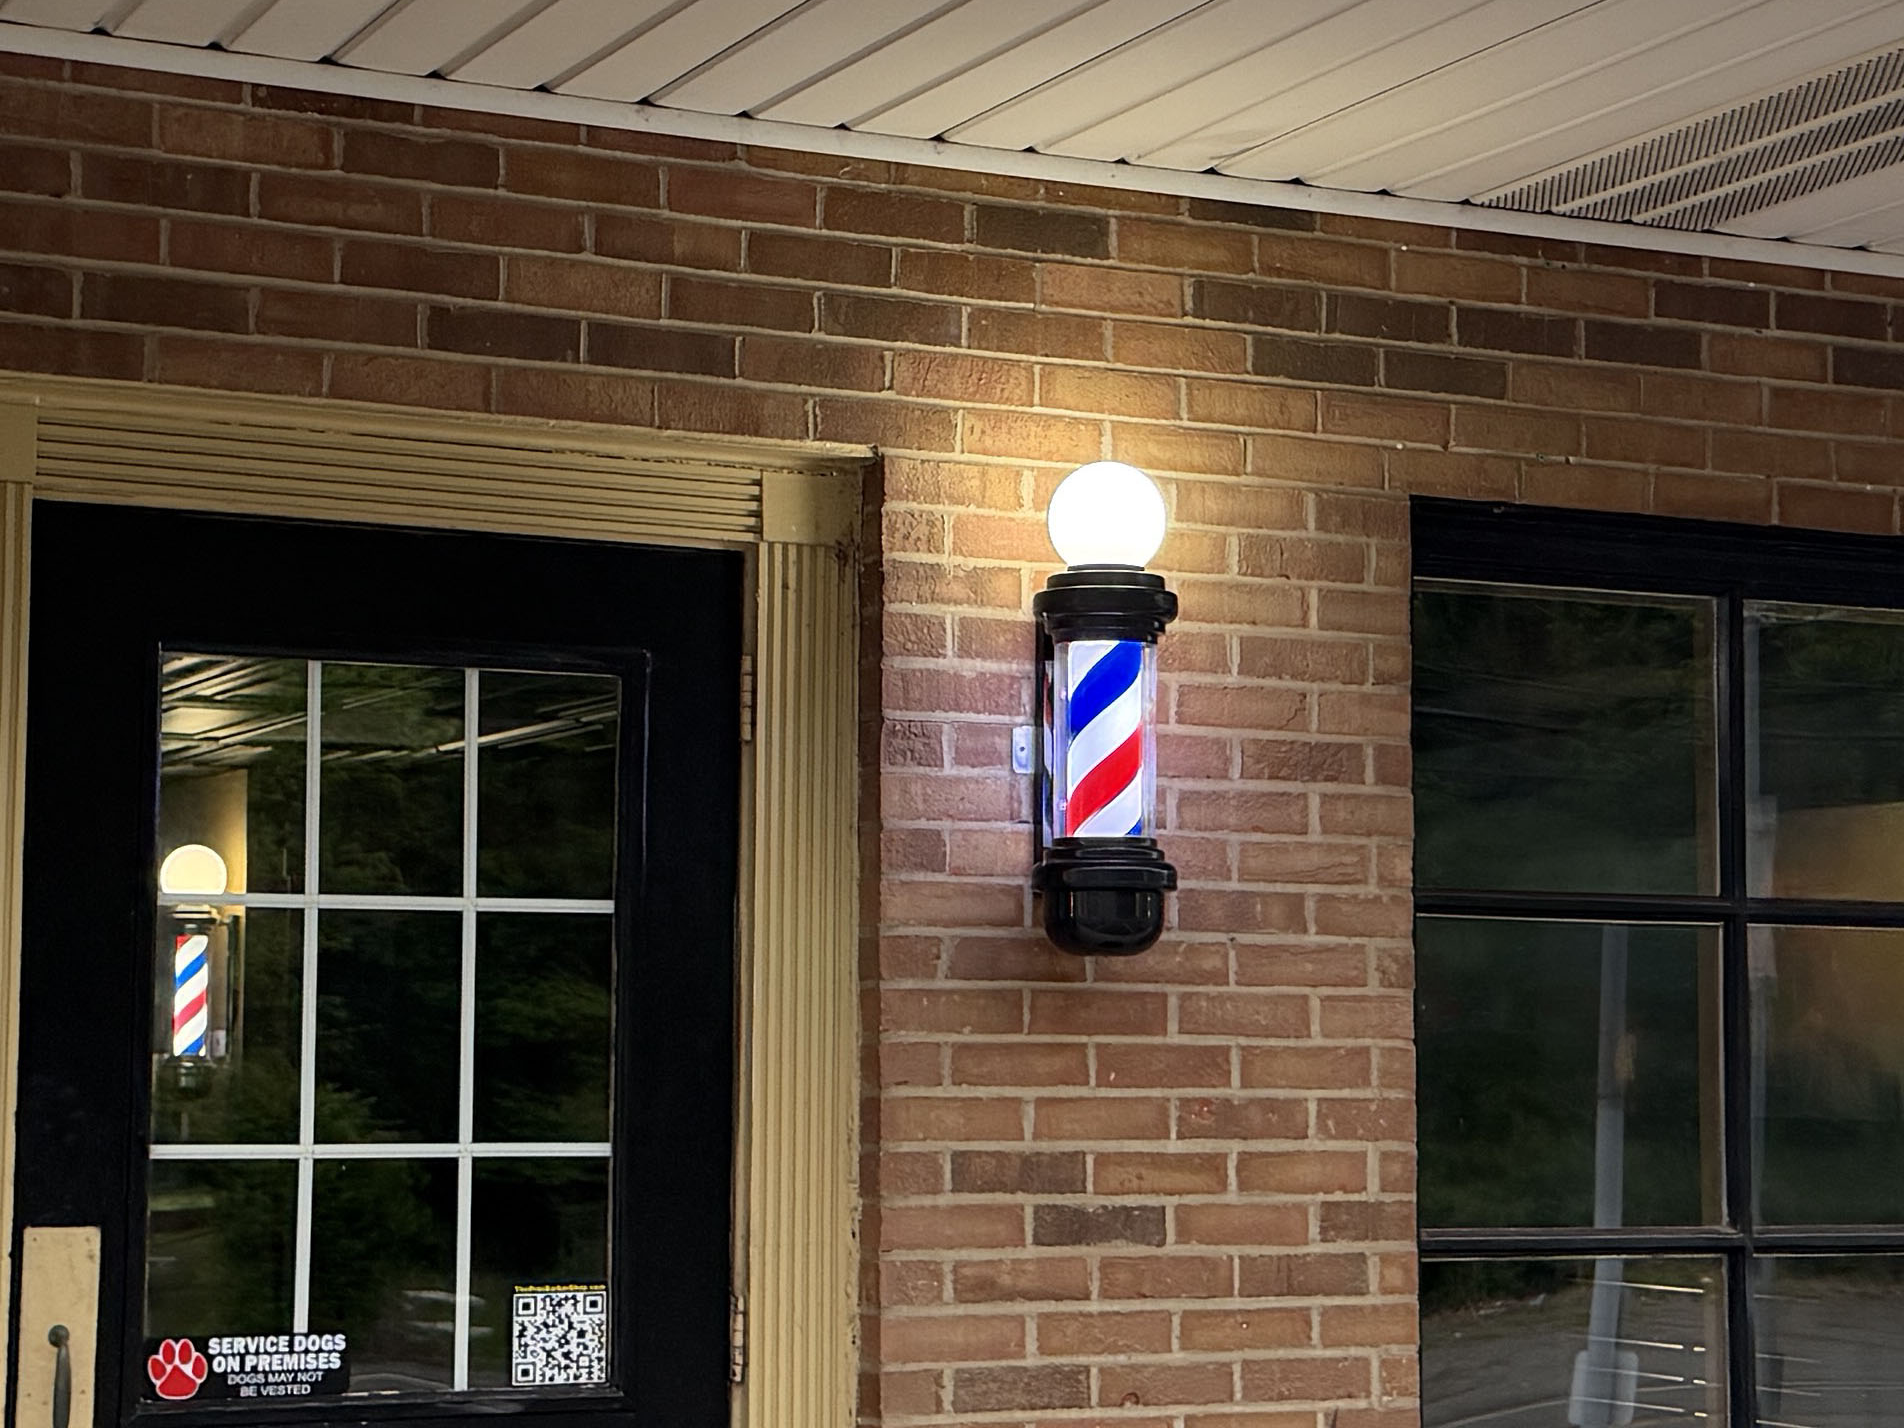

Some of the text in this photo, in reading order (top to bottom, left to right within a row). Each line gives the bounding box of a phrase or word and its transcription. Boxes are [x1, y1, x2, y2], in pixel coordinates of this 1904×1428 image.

[208, 1334, 346, 1355] SERVICE DOGS
[212, 1352, 341, 1373] ON PREMISES
[228, 1371, 324, 1385] DOGS MAY NOT
[240, 1384, 311, 1397] BE VESTED
